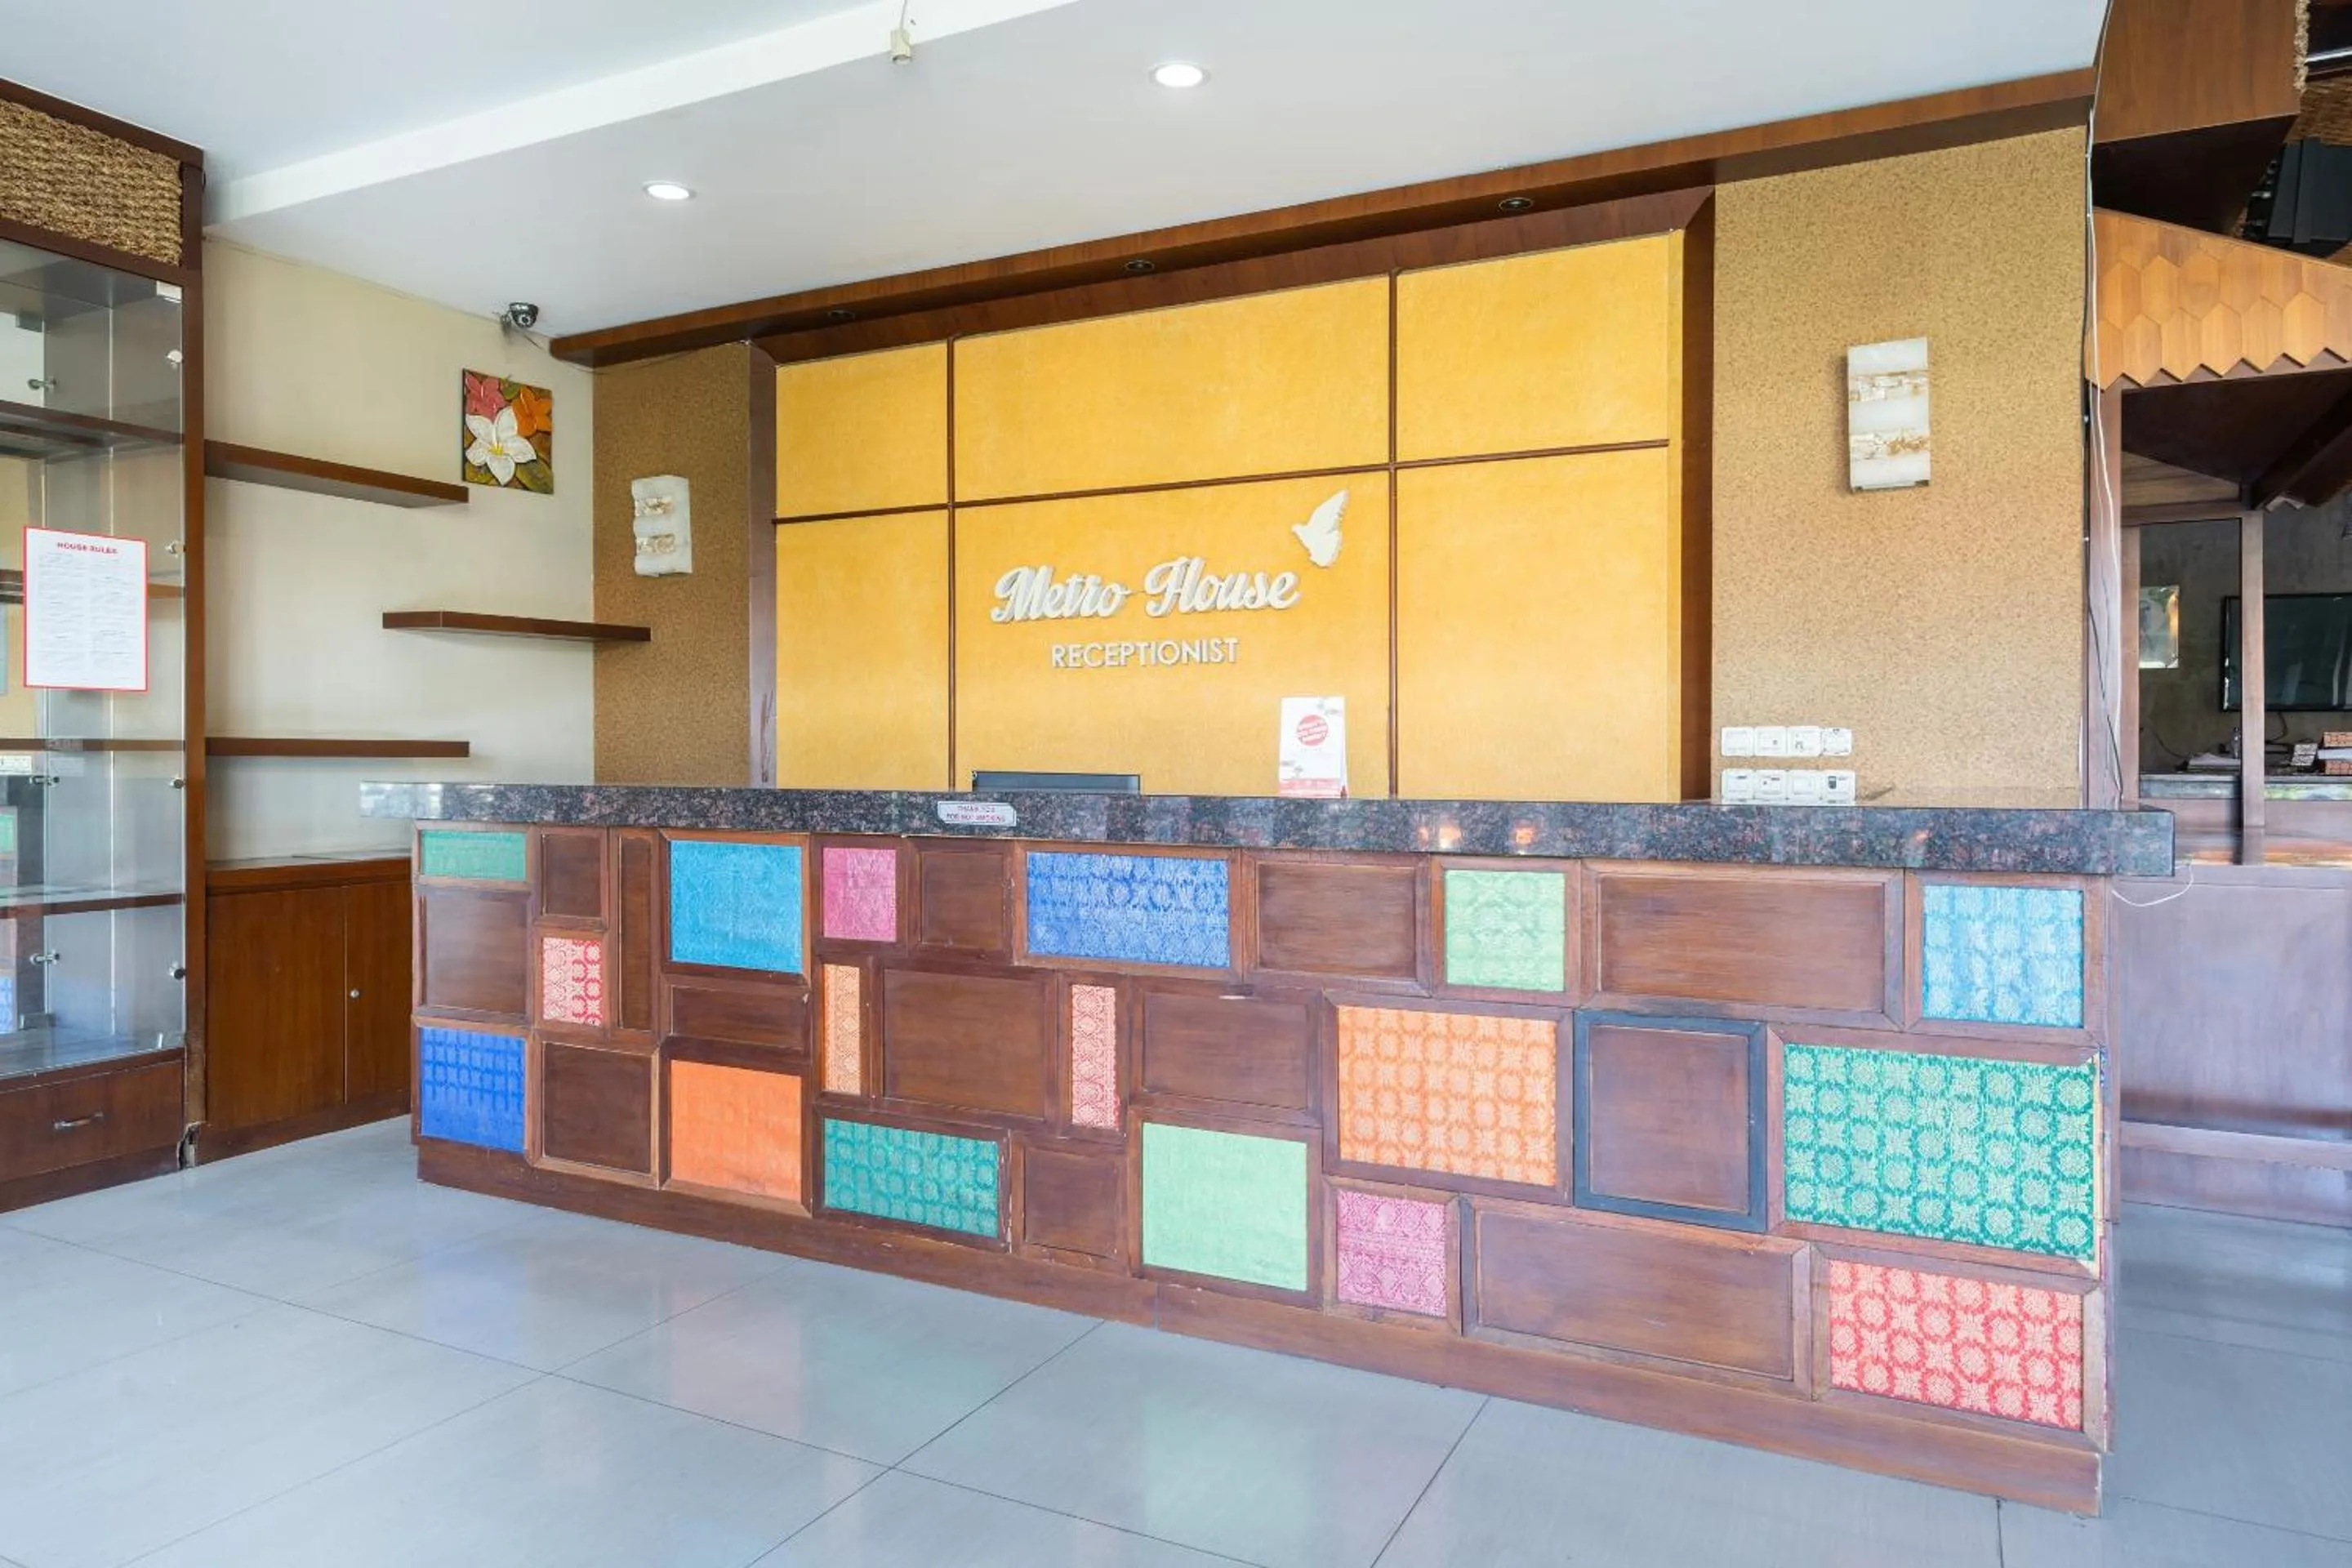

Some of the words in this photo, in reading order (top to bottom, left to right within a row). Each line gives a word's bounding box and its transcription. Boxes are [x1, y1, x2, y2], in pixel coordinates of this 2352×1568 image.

[57, 542, 87, 550] HOUSE
[89, 545, 118, 554] RULES
[991, 564, 1134, 625] Metro
[1143, 556, 1303, 619] House
[1051, 637, 1240, 669] RECEPTIONIST
